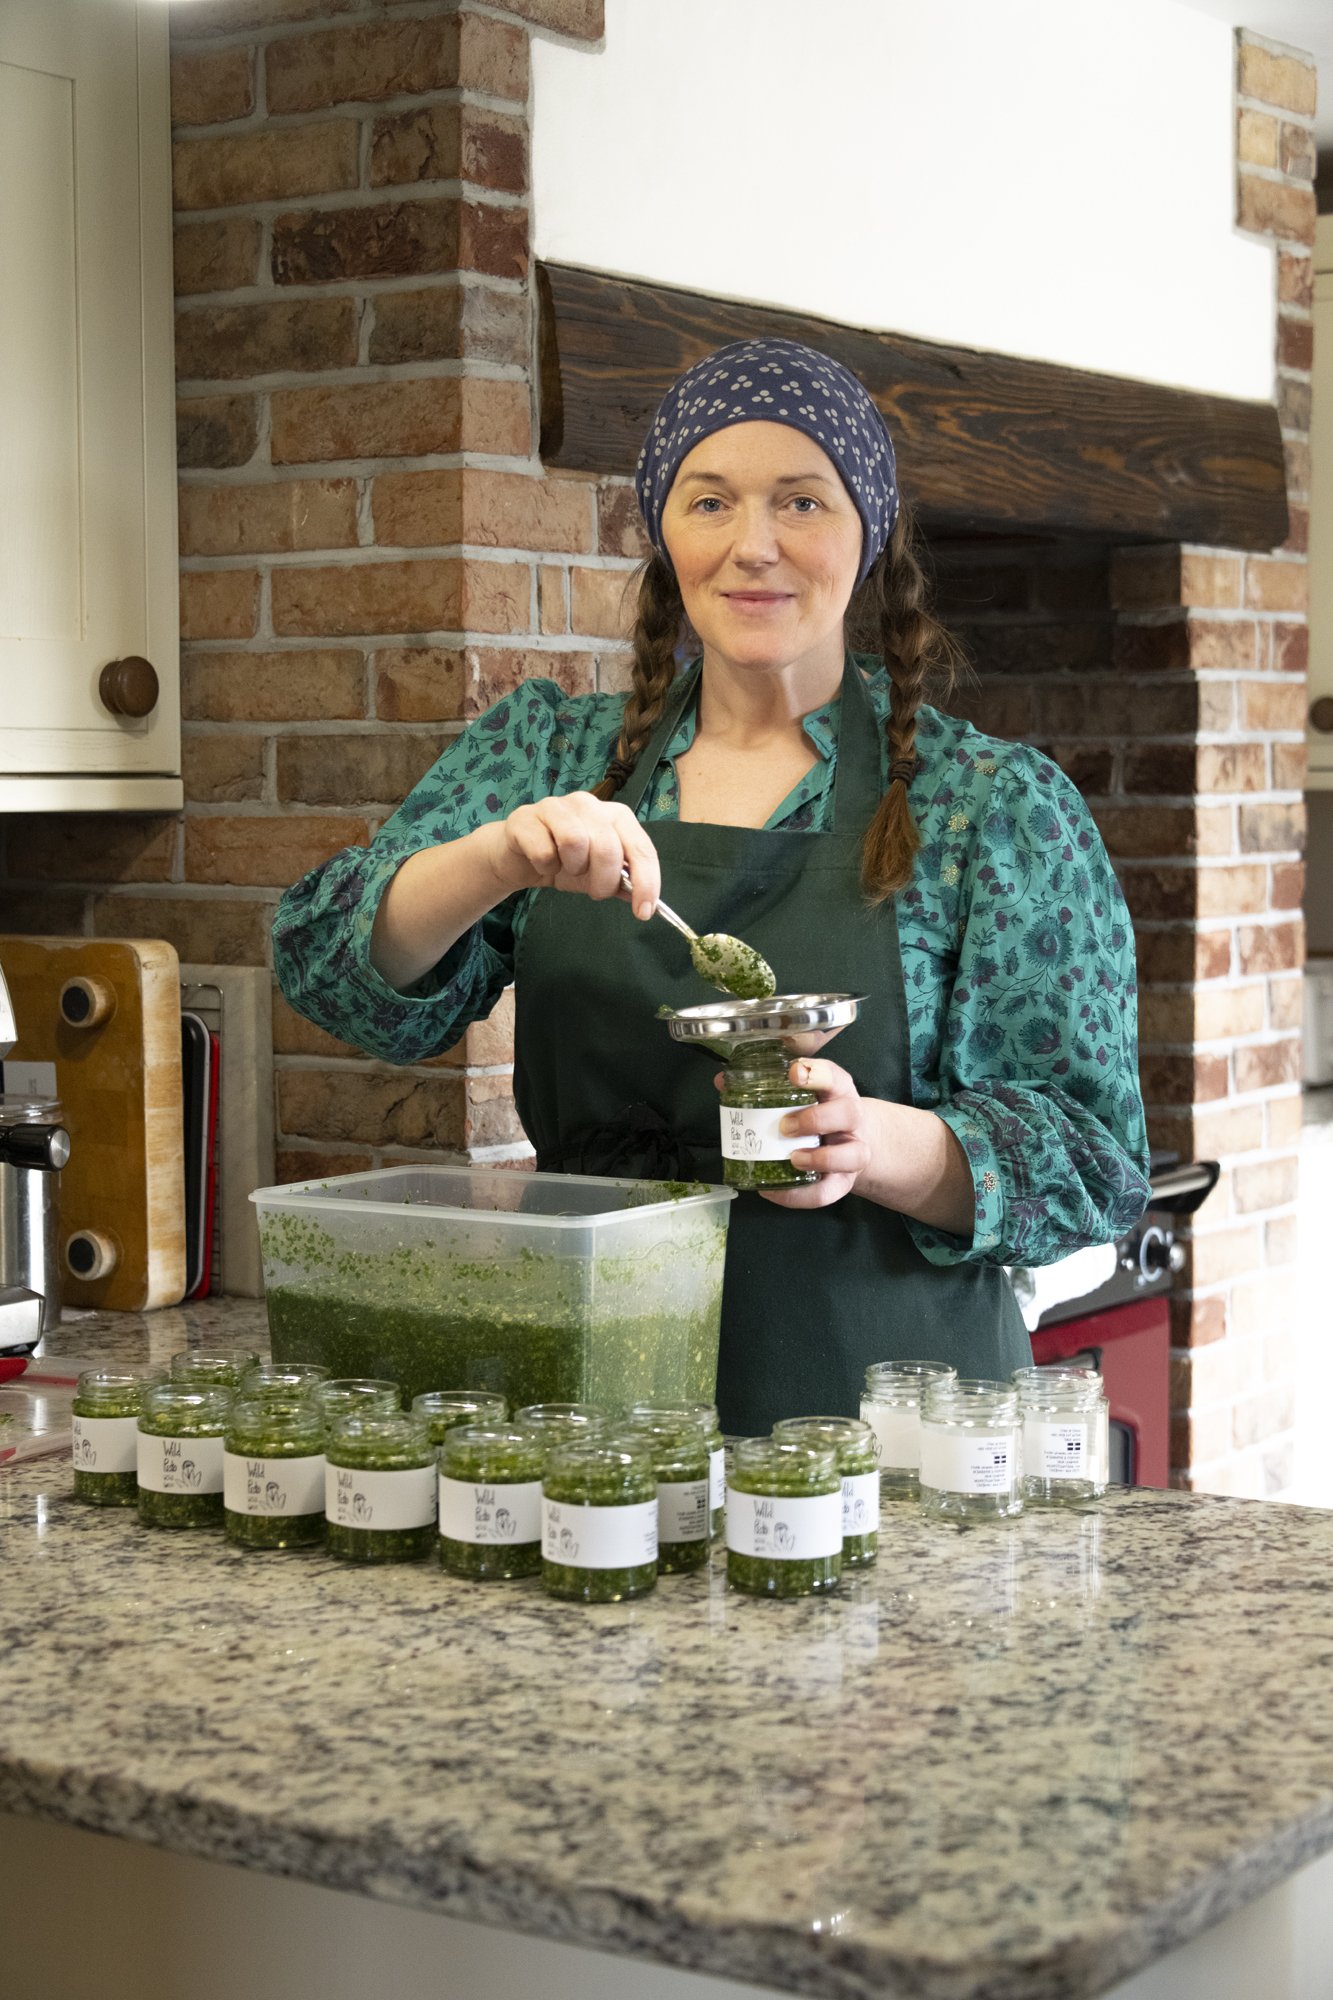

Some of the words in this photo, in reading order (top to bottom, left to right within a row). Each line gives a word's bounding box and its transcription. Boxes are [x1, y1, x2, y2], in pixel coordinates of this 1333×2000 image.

[729, 1110, 744, 1126] Wild
[162, 1439, 181, 1457] Wild
[246, 1460, 265, 1478] Wild
[336, 1470, 353, 1489] Wild
[474, 1487, 496, 1505] Wild
[753, 1499, 774, 1518] Wild
